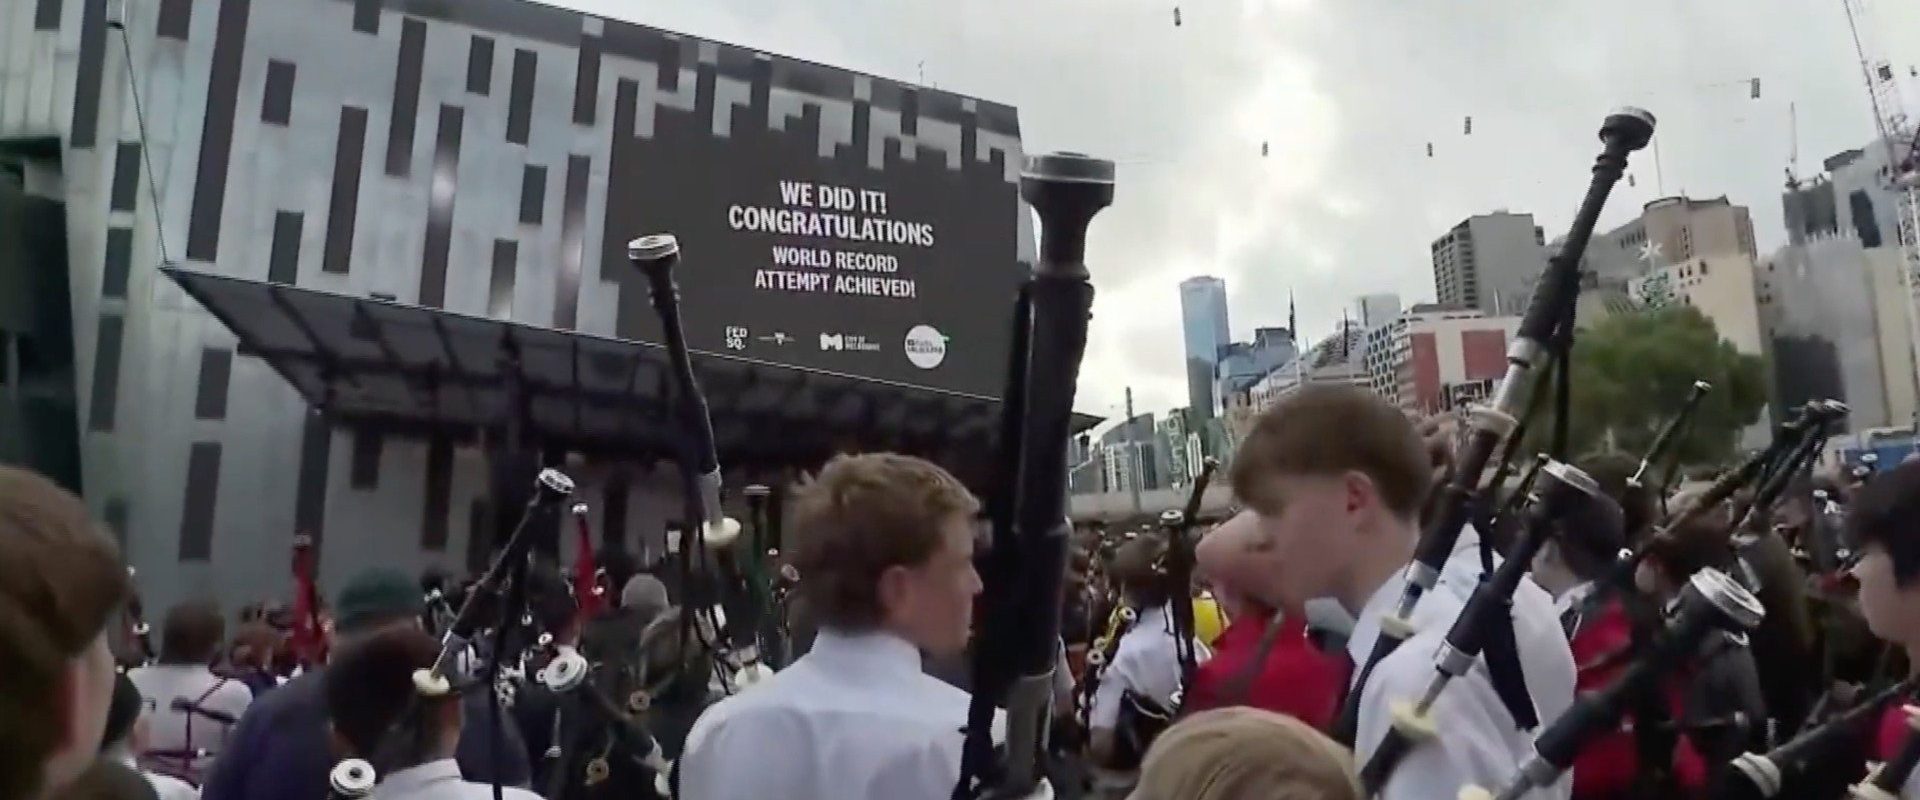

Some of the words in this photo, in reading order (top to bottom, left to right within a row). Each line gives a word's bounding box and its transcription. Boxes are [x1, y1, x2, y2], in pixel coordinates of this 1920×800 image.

[780, 180, 813, 207] WE
[819, 185, 855, 211] DID
[860, 189, 887, 214] IT!
[728, 205, 934, 246] CONGRATULATIONS
[773, 246, 831, 268] WORLD
[835, 250, 898, 272] RECORD
[755, 270, 830, 292] ATTEMPT
[834, 276, 916, 298] ACHIEVED!
[726, 326, 748, 338] FED
